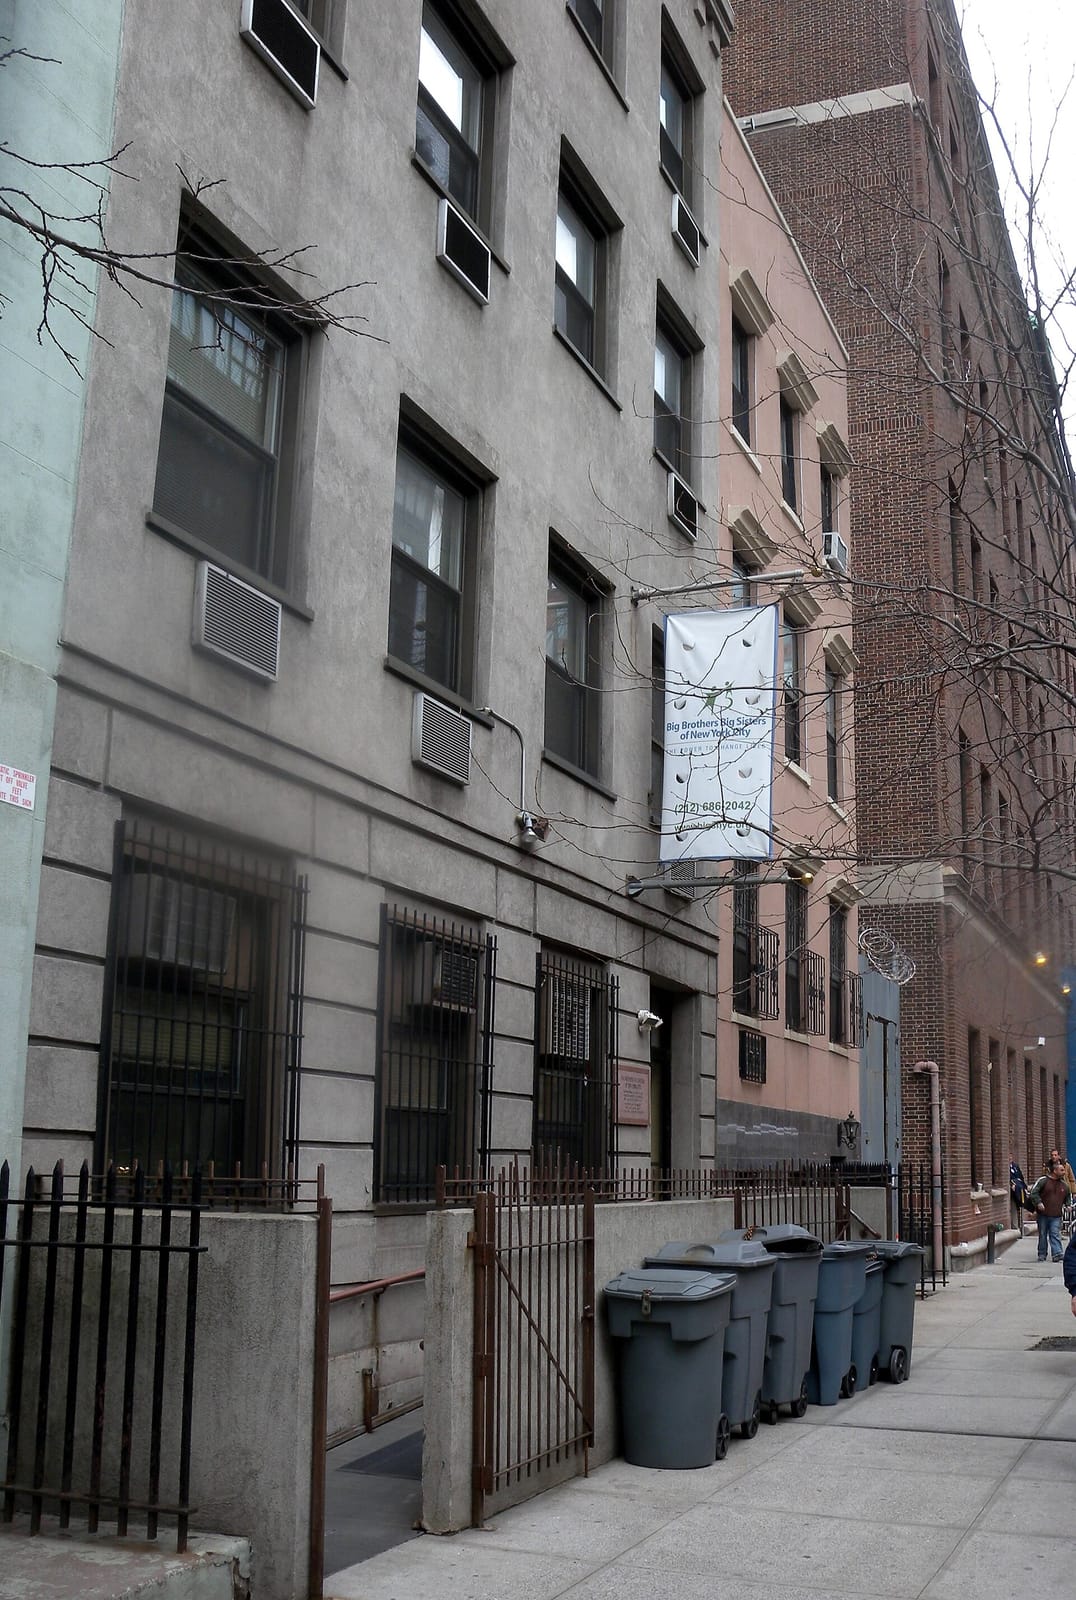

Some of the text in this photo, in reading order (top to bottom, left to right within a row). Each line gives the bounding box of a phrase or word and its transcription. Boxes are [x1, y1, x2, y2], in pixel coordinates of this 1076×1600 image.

[666, 716, 767, 732] Big Brothers Big Sisters
[680, 727, 751, 740] of New York City
[674, 801, 751, 815] (212) 6862042
